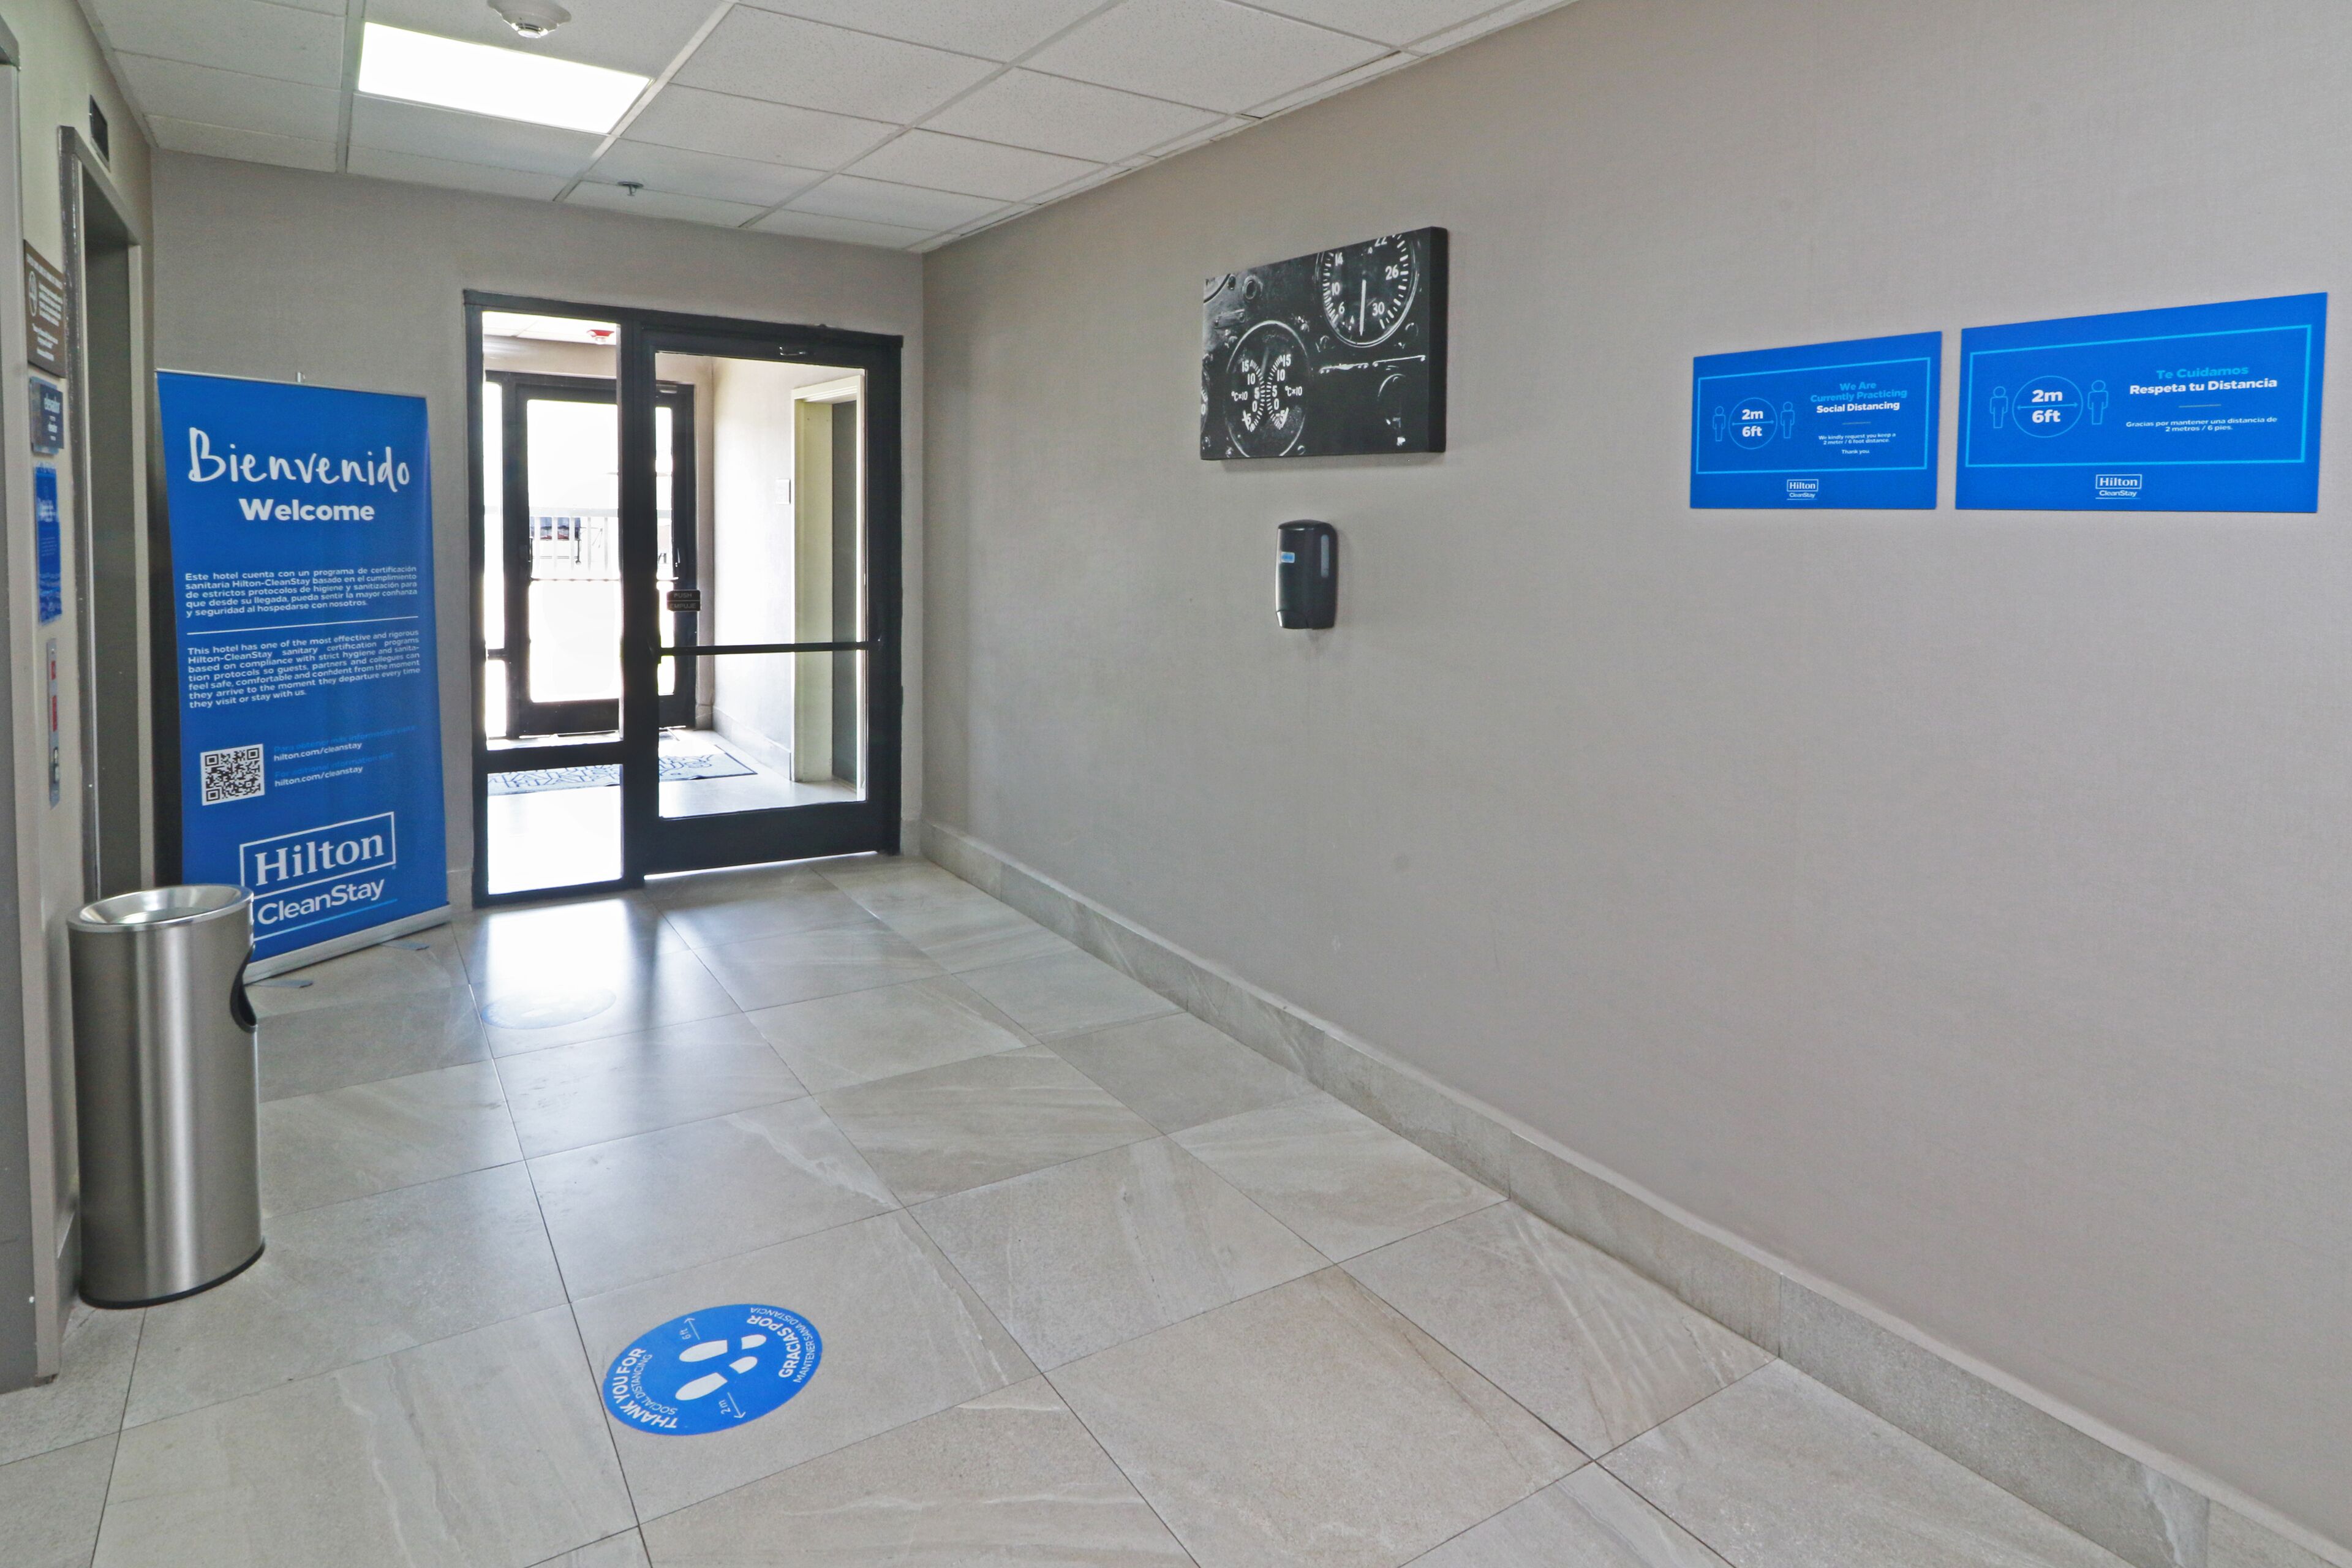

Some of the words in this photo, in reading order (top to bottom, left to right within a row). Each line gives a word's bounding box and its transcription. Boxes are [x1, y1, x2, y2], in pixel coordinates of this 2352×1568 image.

[1335, 252, 1343, 266] 14
[1385, 264, 1399, 281] 26
[1332, 282, 1341, 296] 10
[1338, 301, 1345, 314] 6
[1372, 301, 1385, 316] 30
[1242, 360, 1250, 372] 15
[1283, 353, 1291, 366] 15
[1247, 372, 1256, 385] 10
[1276, 369, 1286, 381] 10
[2155, 370, 2173, 380] Te
[2176, 366, 2249, 379] Cuidamos
[1254, 386, 1260, 399] 5
[1272, 385, 1278, 397] 5
[1839, 383, 1856, 391] We
[2130, 383, 2186, 396] Respeta
[2189, 382, 2205, 391] tu
[2207, 378, 2277, 391] Distancia
[1811, 393, 1855, 403] Currently
[1856, 389, 1907, 400] Practicing
[2032, 389, 2063, 403] 2m
[1816, 404, 1845, 413] Social
[1847, 401, 1900, 412] Distancing
[1741, 409, 1763, 420] 2m
[2032, 409, 2061, 423] 6ft
[1742, 426, 1762, 437] 6ft
[188, 427, 410, 492] Bienvenido
[2099, 477, 2138, 487] Hilton
[239, 498, 375, 521] Welcome
[185, 581, 230, 590] sanitaria
[232, 578, 310, 587] Hilton-CleanStay
[248, 587, 298, 597] protocolos
[313, 584, 344, 593] higiene
[209, 597, 238, 606] desde
[291, 594, 318, 603] pueda
[195, 606, 245, 617] seguridad
[257, 603, 309, 612] hospedarse
[213, 644, 238, 653] hotel
[333, 634, 371, 643] effective
[188, 650, 273, 663] Hilton-CleanStay
[188, 663, 220, 673] based
[239, 657, 293, 668] compliance
[296, 654, 315, 662] with
[342, 649, 375, 658] hygiene
[214, 668, 260, 680] protocols
[312, 660, 347, 670] partners
[189, 681, 208, 690] feel
[235, 673, 292, 685] comfortable
[216, 687, 244, 696] arrive
[278, 679, 316, 688] moment
[338, 673, 379, 682] departure
[216, 696, 236, 705] visit
[274, 742, 363, 761] hilton.com/cleanstay
[274, 766, 363, 787] hilton.com/cleanstay
[255, 834, 384, 886] Hilton
[257, 879, 385, 925] CleanStay
[747, 1315, 783, 1331] POR
[750, 1307, 799, 1325] DISTANCIA
[679, 1328, 692, 1340] 6ft
[795, 1322, 813, 1341] SANA
[777, 1327, 801, 1378] GRACIAS
[616, 1348, 647, 1374] FOR
[793, 1341, 815, 1382] MANTENER
[631, 1354, 653, 1399] DISTANCING
[612, 1376, 630, 1403] YOU
[641, 1396, 678, 1415] SOCIAL
[718, 1400, 731, 1414] 2m
[619, 1400, 678, 1428] THANK
